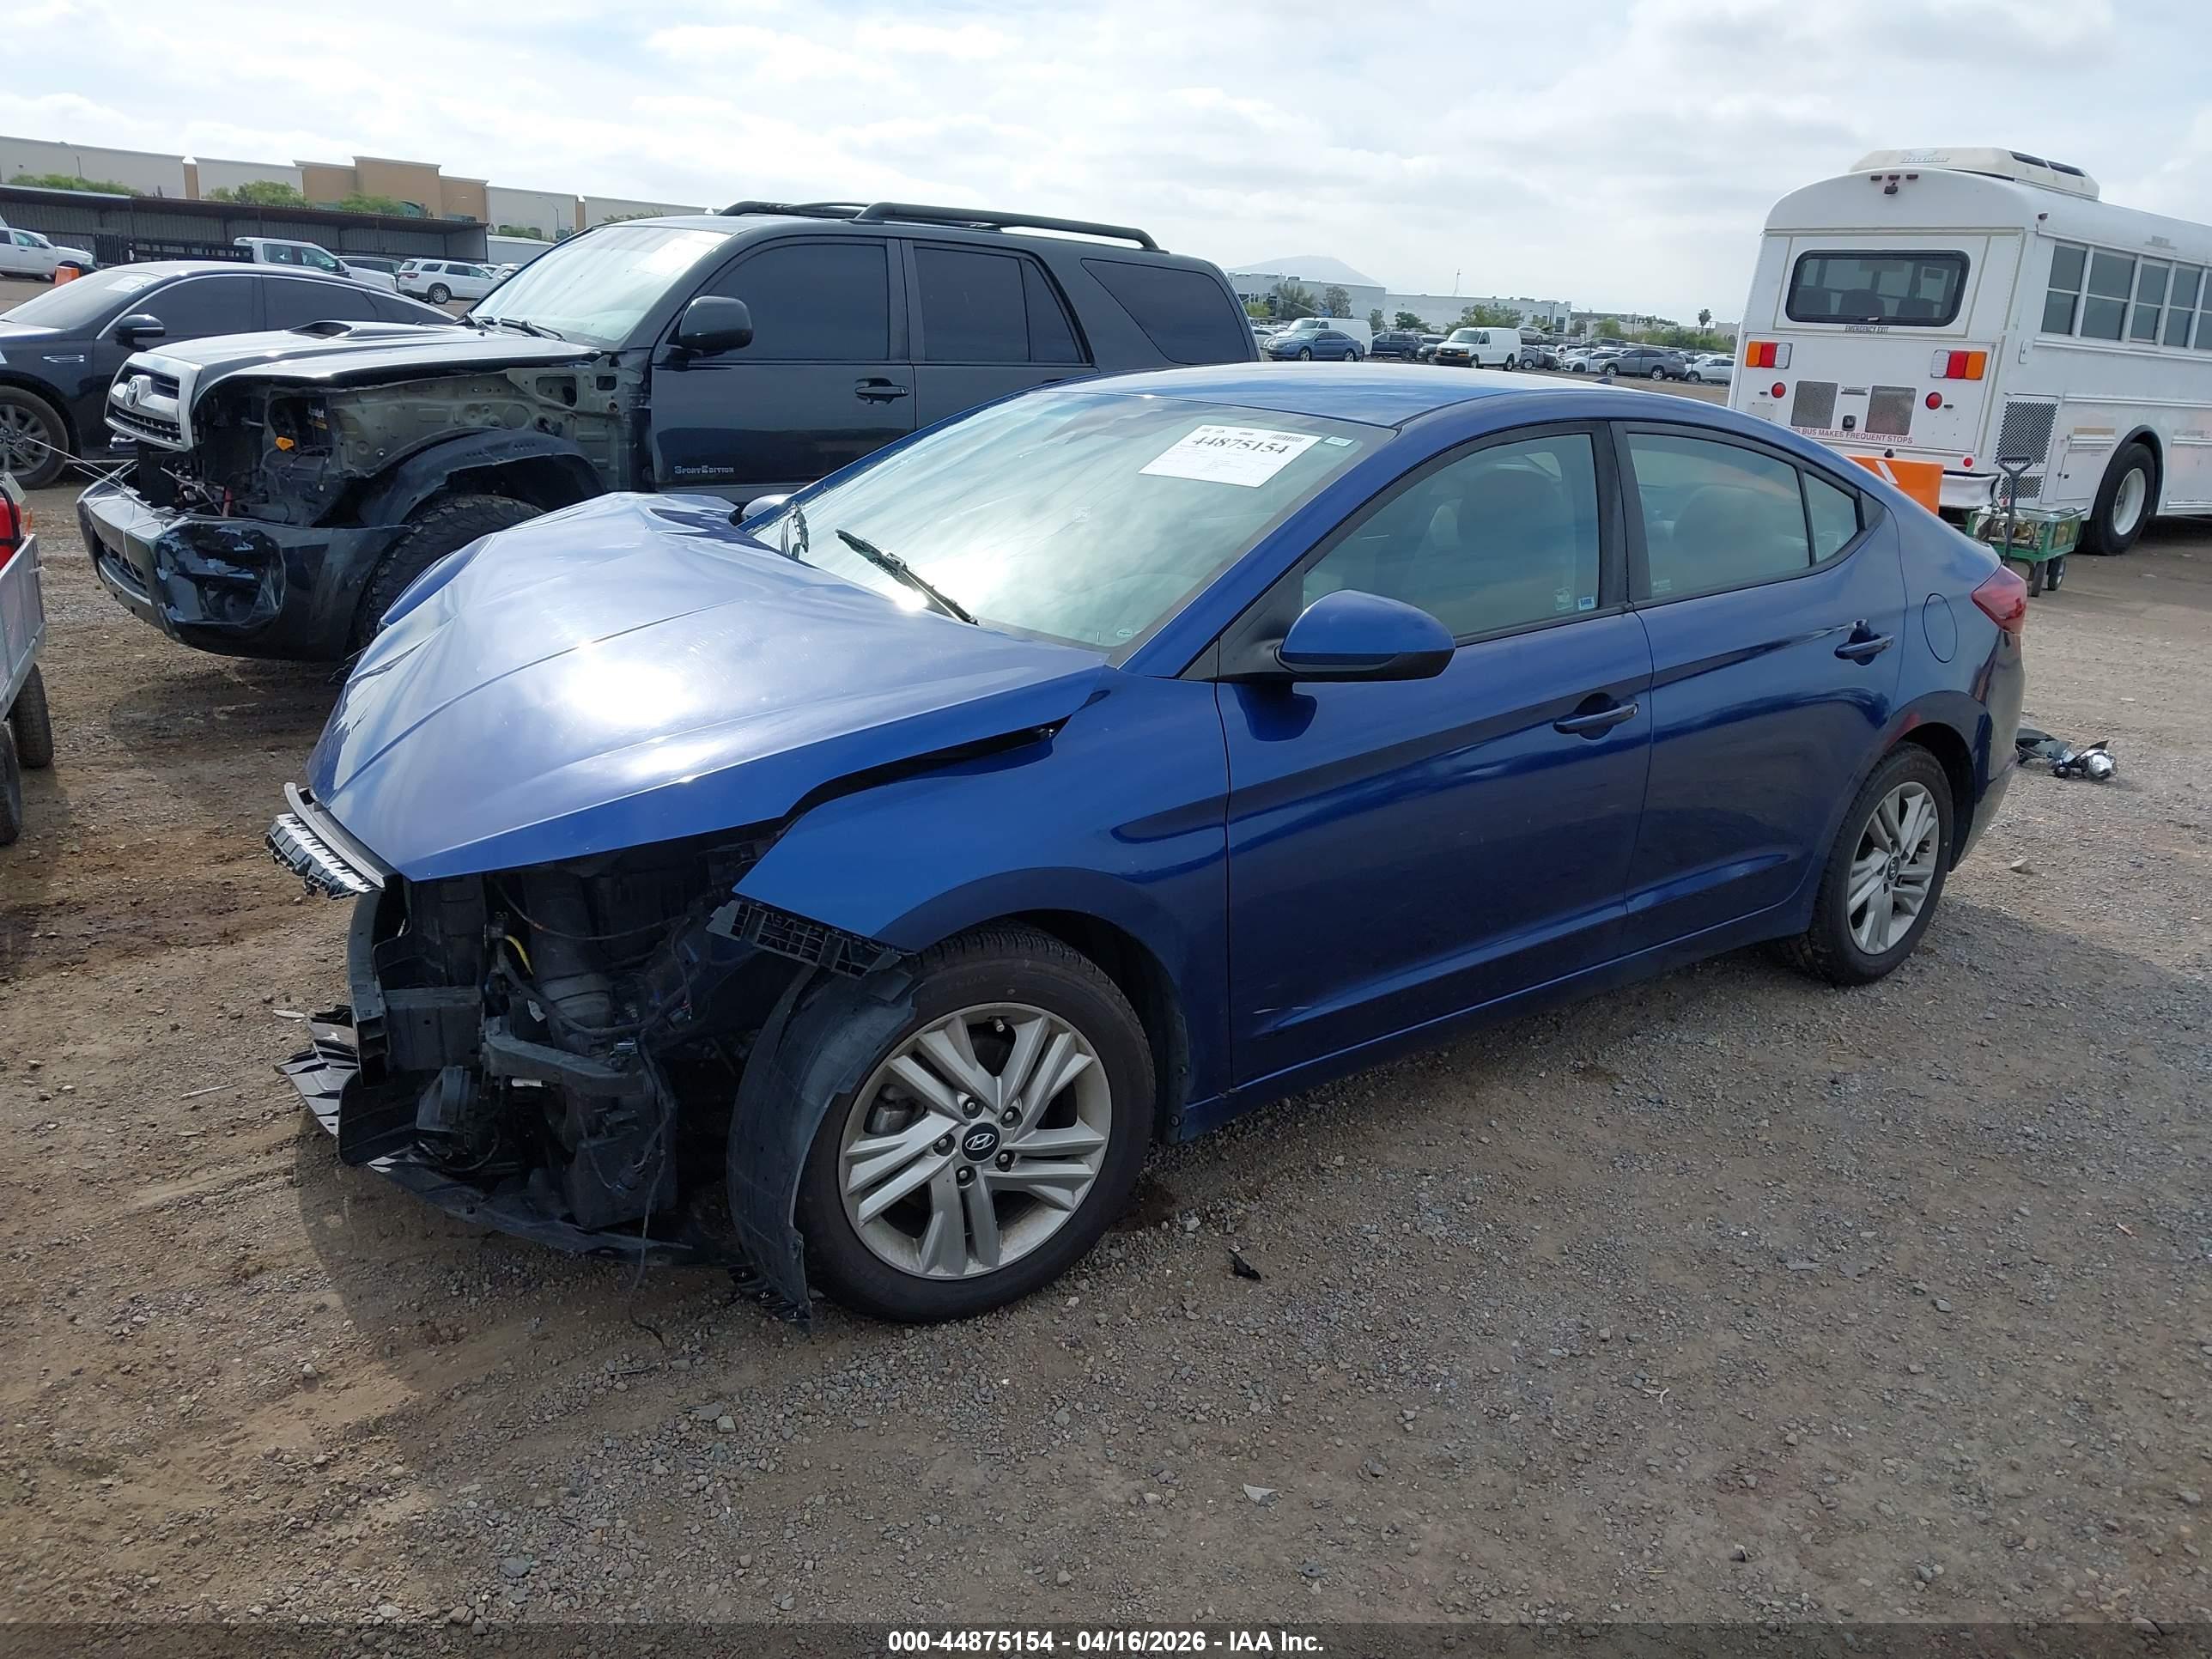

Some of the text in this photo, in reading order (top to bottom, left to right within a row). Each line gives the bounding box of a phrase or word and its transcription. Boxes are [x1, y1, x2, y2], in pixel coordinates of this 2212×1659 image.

[1844, 325, 1877, 333] EMERGENCY
[1818, 429, 1844, 438] MAKES
[1845, 432, 1887, 441] FREQUENT
[1887, 435, 1913, 444] STOPS
[1192, 435, 1291, 454] 44875154
